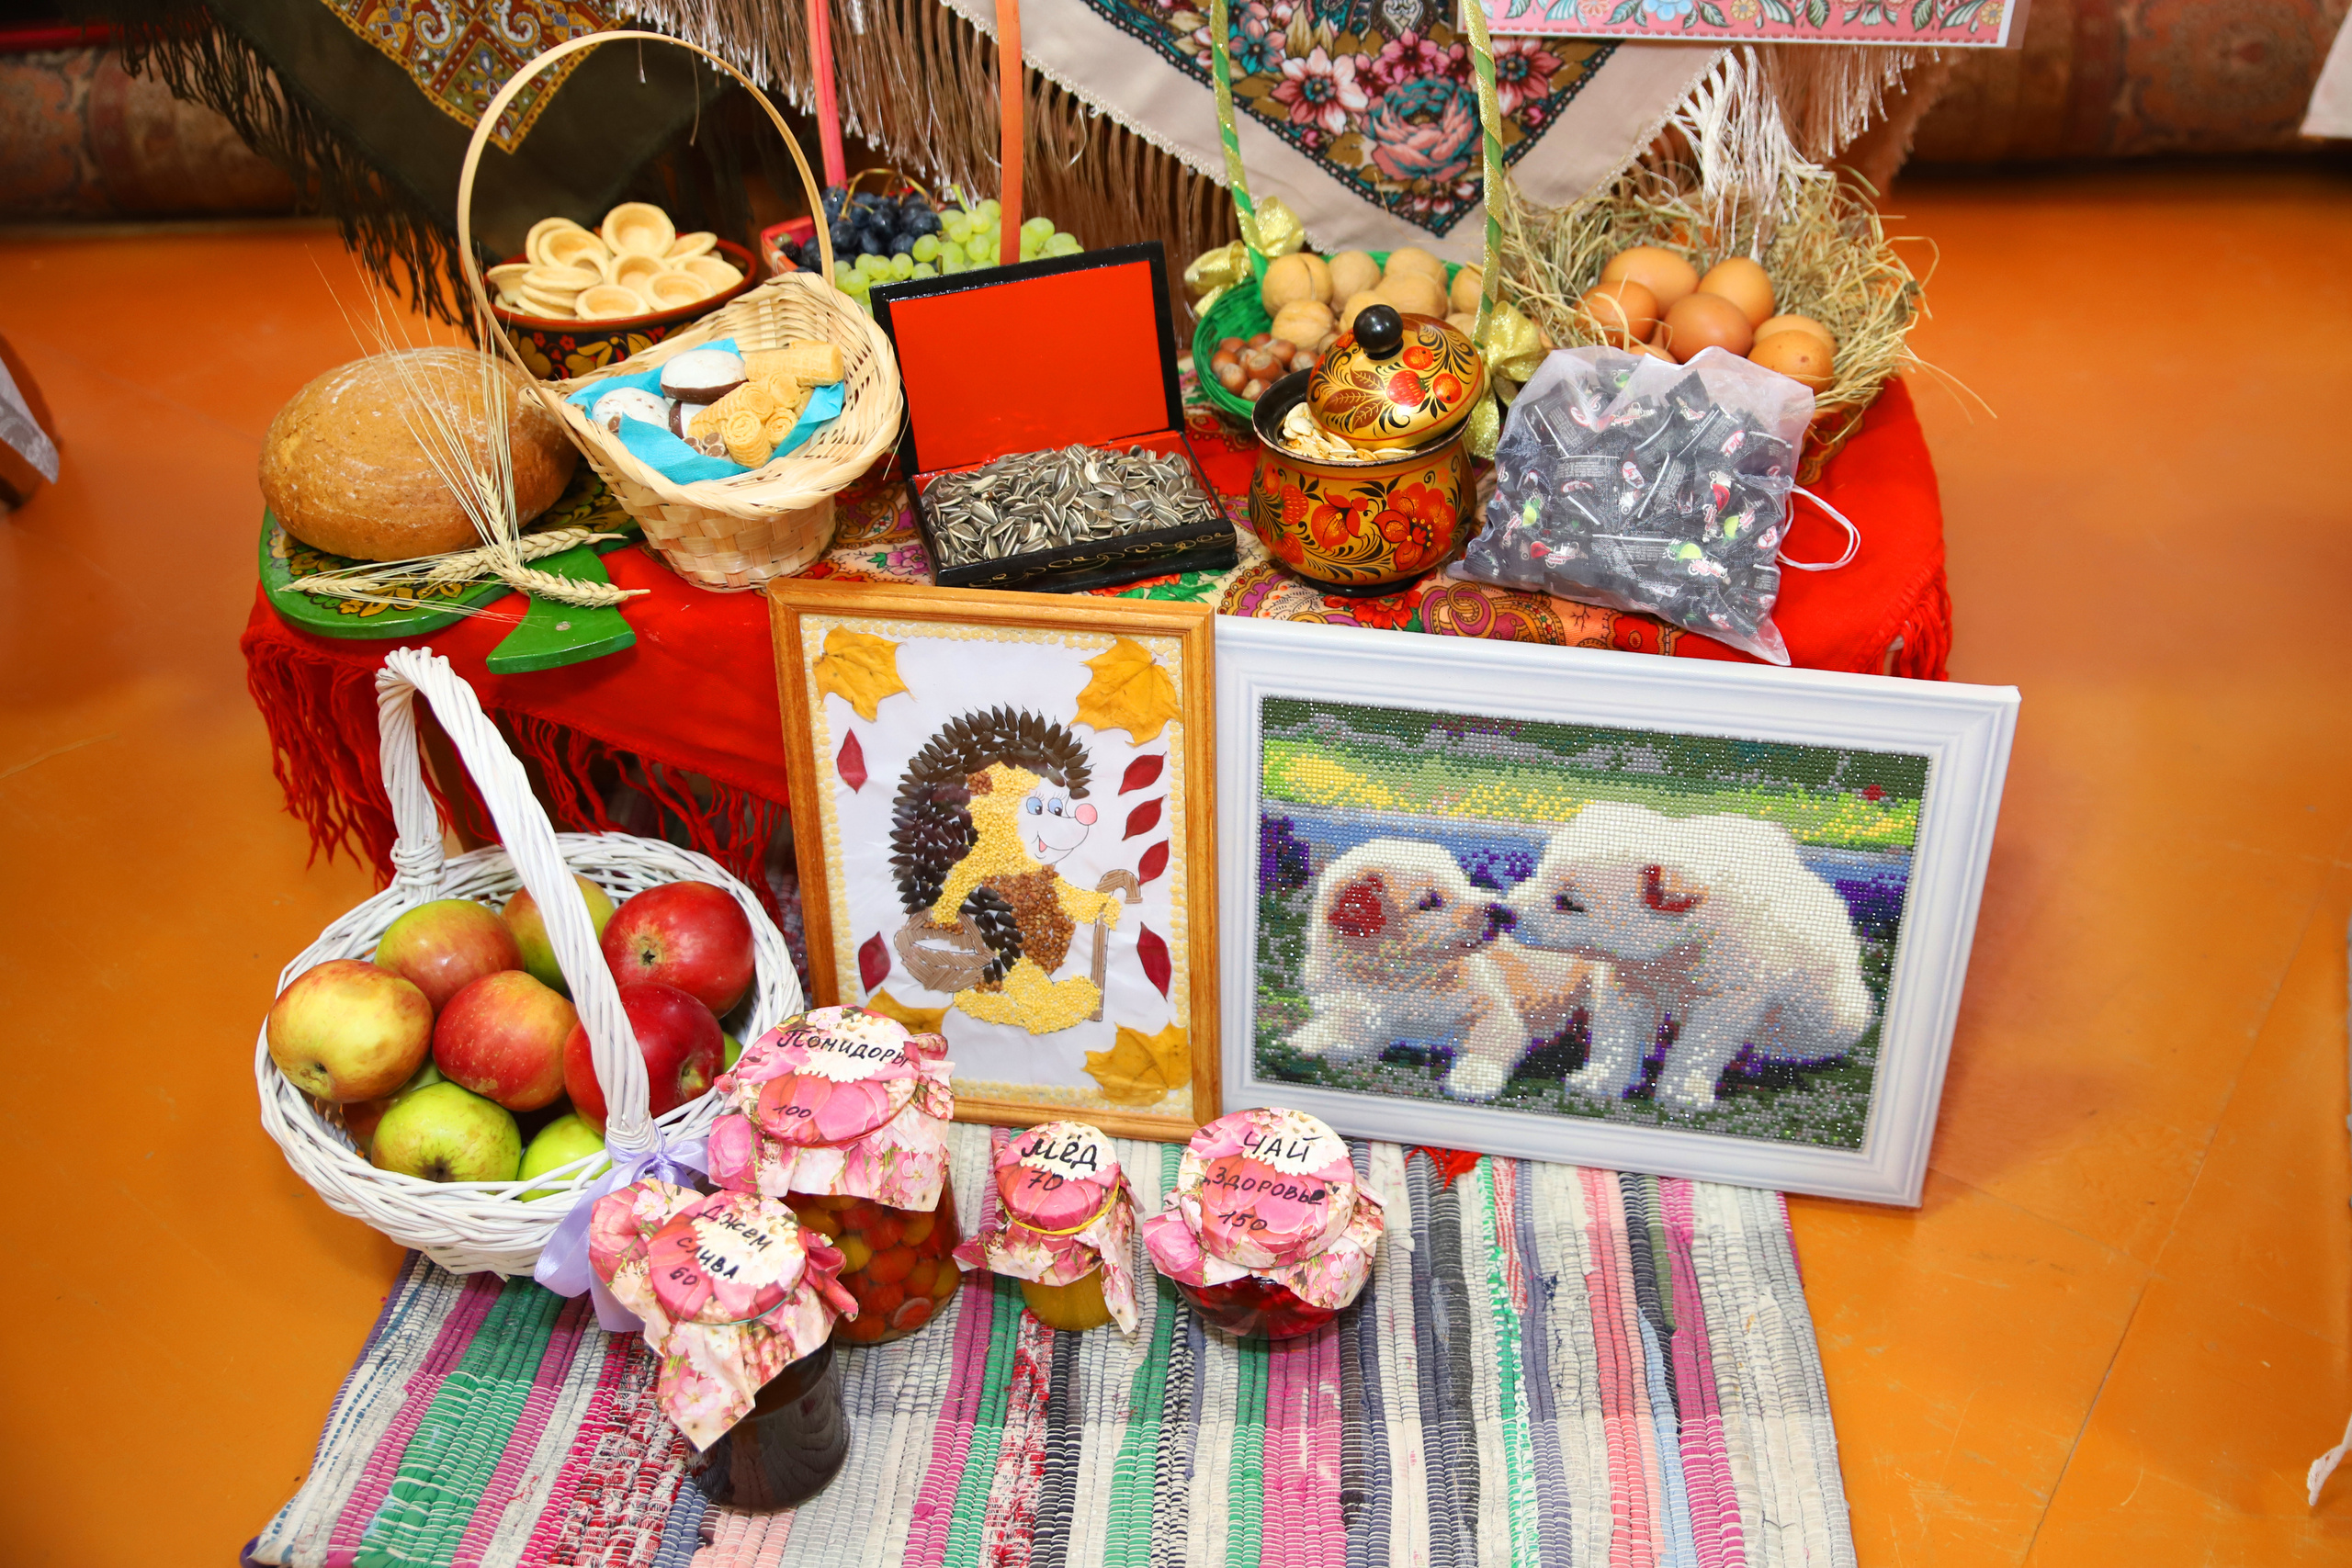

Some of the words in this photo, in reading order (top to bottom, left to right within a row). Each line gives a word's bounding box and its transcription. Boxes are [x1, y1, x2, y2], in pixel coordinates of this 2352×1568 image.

[773, 1104, 812, 1119] 100
[1243, 1131, 1323, 1163] ЧАЙ
[1027, 1169, 1064, 1191] 70
[1218, 1210, 1268, 1231] 150
